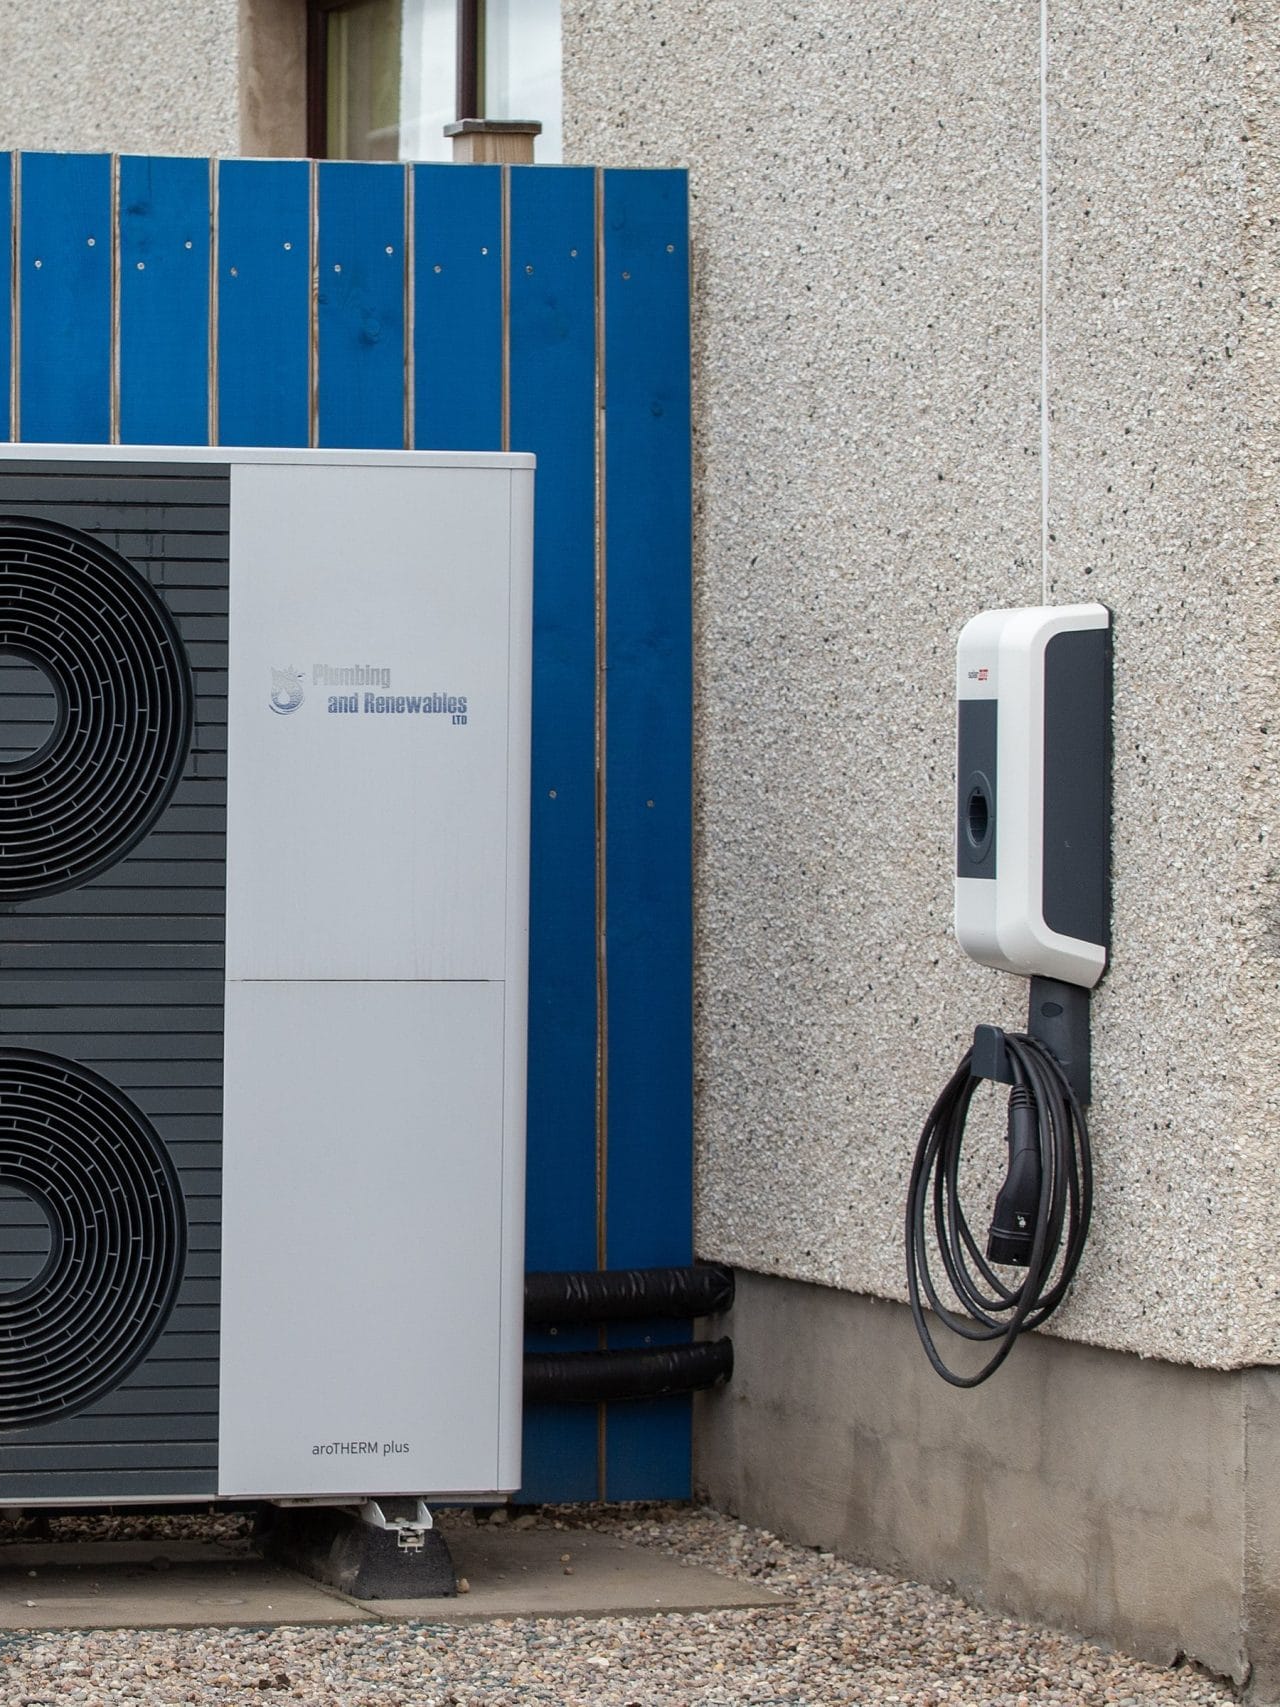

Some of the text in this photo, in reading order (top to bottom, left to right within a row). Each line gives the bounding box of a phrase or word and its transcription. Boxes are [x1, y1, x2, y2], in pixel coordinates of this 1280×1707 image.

[312, 664, 391, 688] Plumbing
[327, 692, 468, 714] and Renewables
[452, 715, 468, 725] LTD
[312, 1440, 410, 1457] aroTHERM plus
